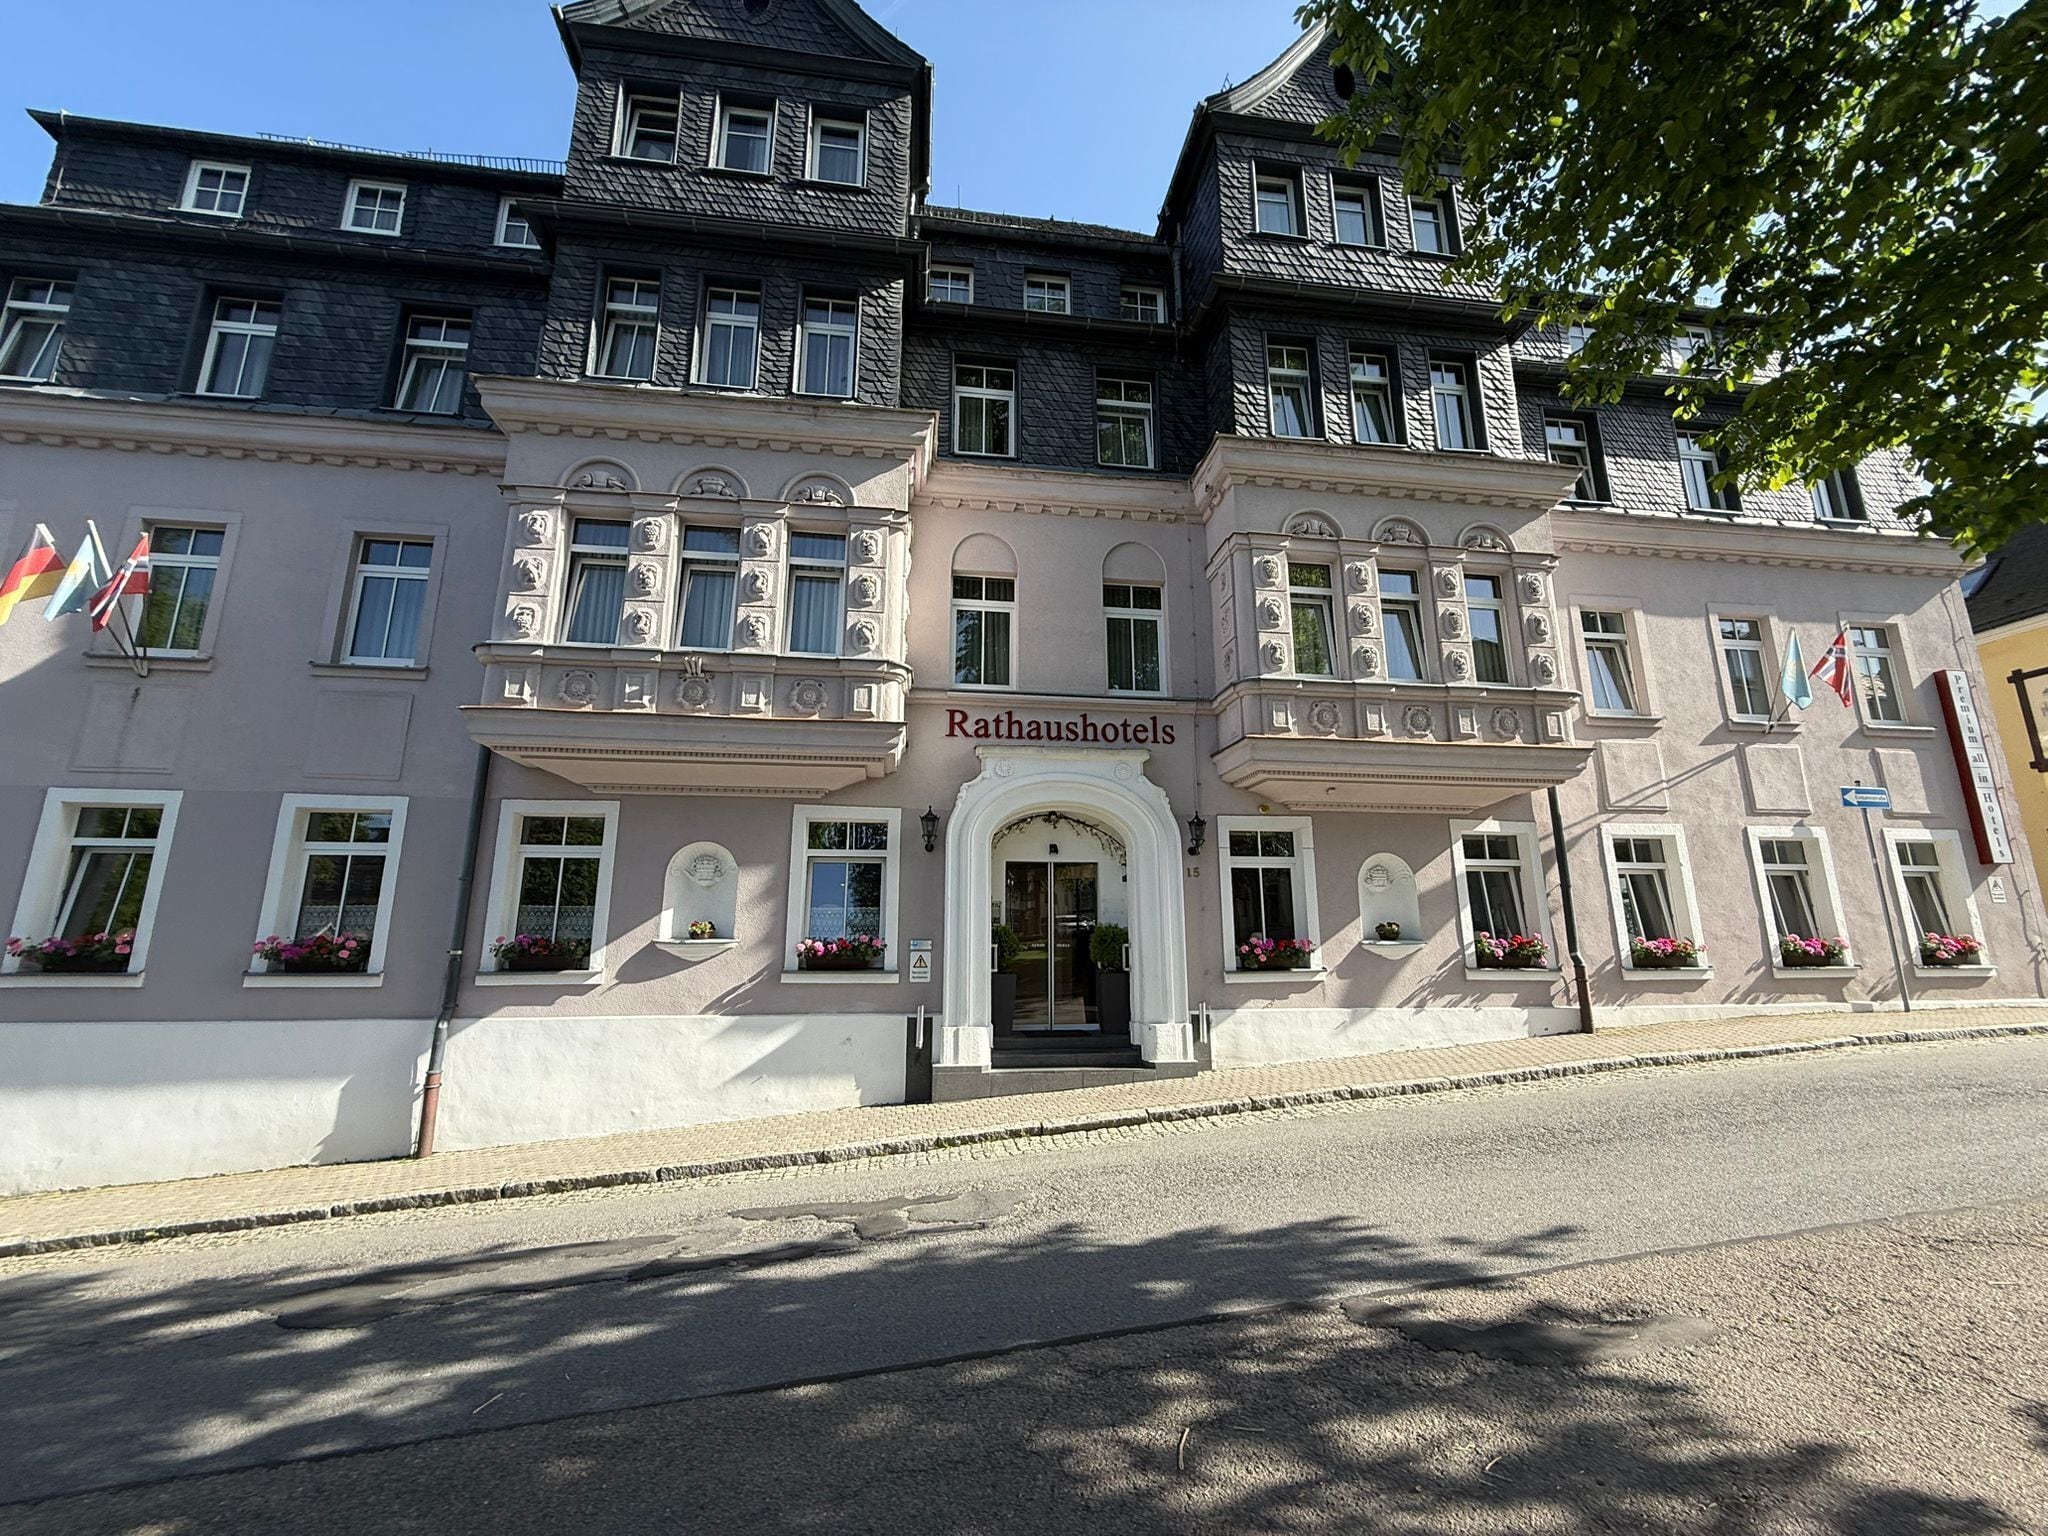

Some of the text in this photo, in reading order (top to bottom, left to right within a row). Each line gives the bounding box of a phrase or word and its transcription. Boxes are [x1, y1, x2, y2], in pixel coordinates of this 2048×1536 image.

[945, 709, 1176, 744] Rathaushotels
[1954, 674, 2005, 858] Premium all in Hotels
[1186, 867, 1200, 878] 15
